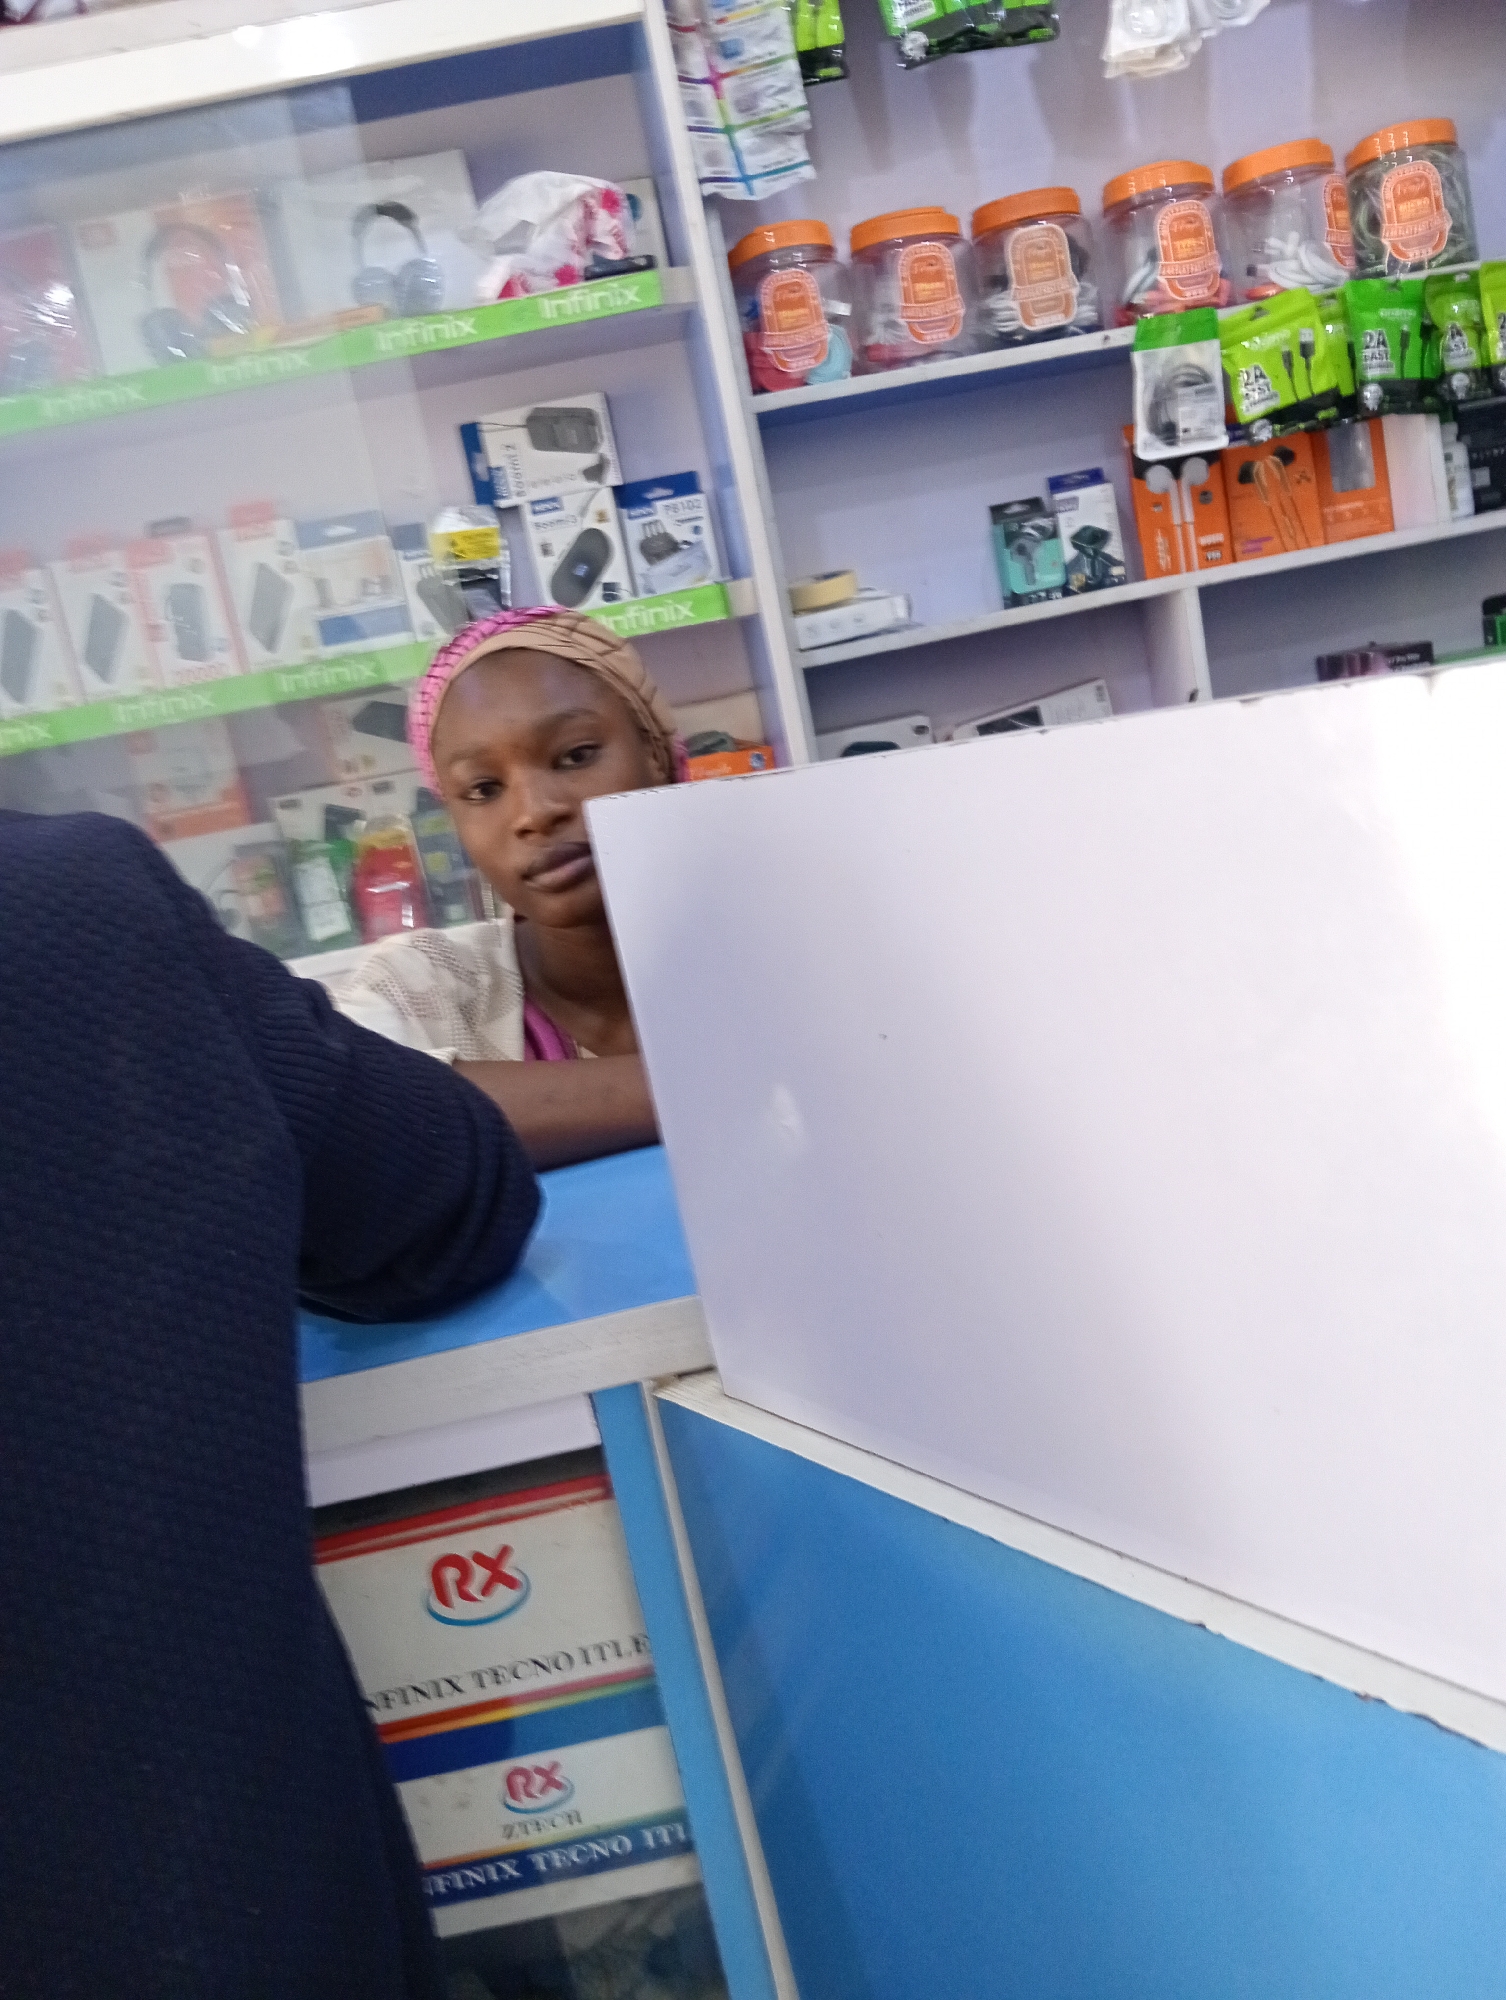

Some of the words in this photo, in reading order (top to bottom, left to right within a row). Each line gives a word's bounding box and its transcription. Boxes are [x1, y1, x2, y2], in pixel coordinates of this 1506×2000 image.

[375, 314, 478, 352] Infinix
[539, 283, 641, 320] Infinix
[279, 657, 379, 693] Infinix
[431, 1543, 523, 1610] RX
[471, 1651, 575, 1691] TECNO
[505, 1761, 567, 1804] RX
[527, 1834, 633, 1873] TECNO
